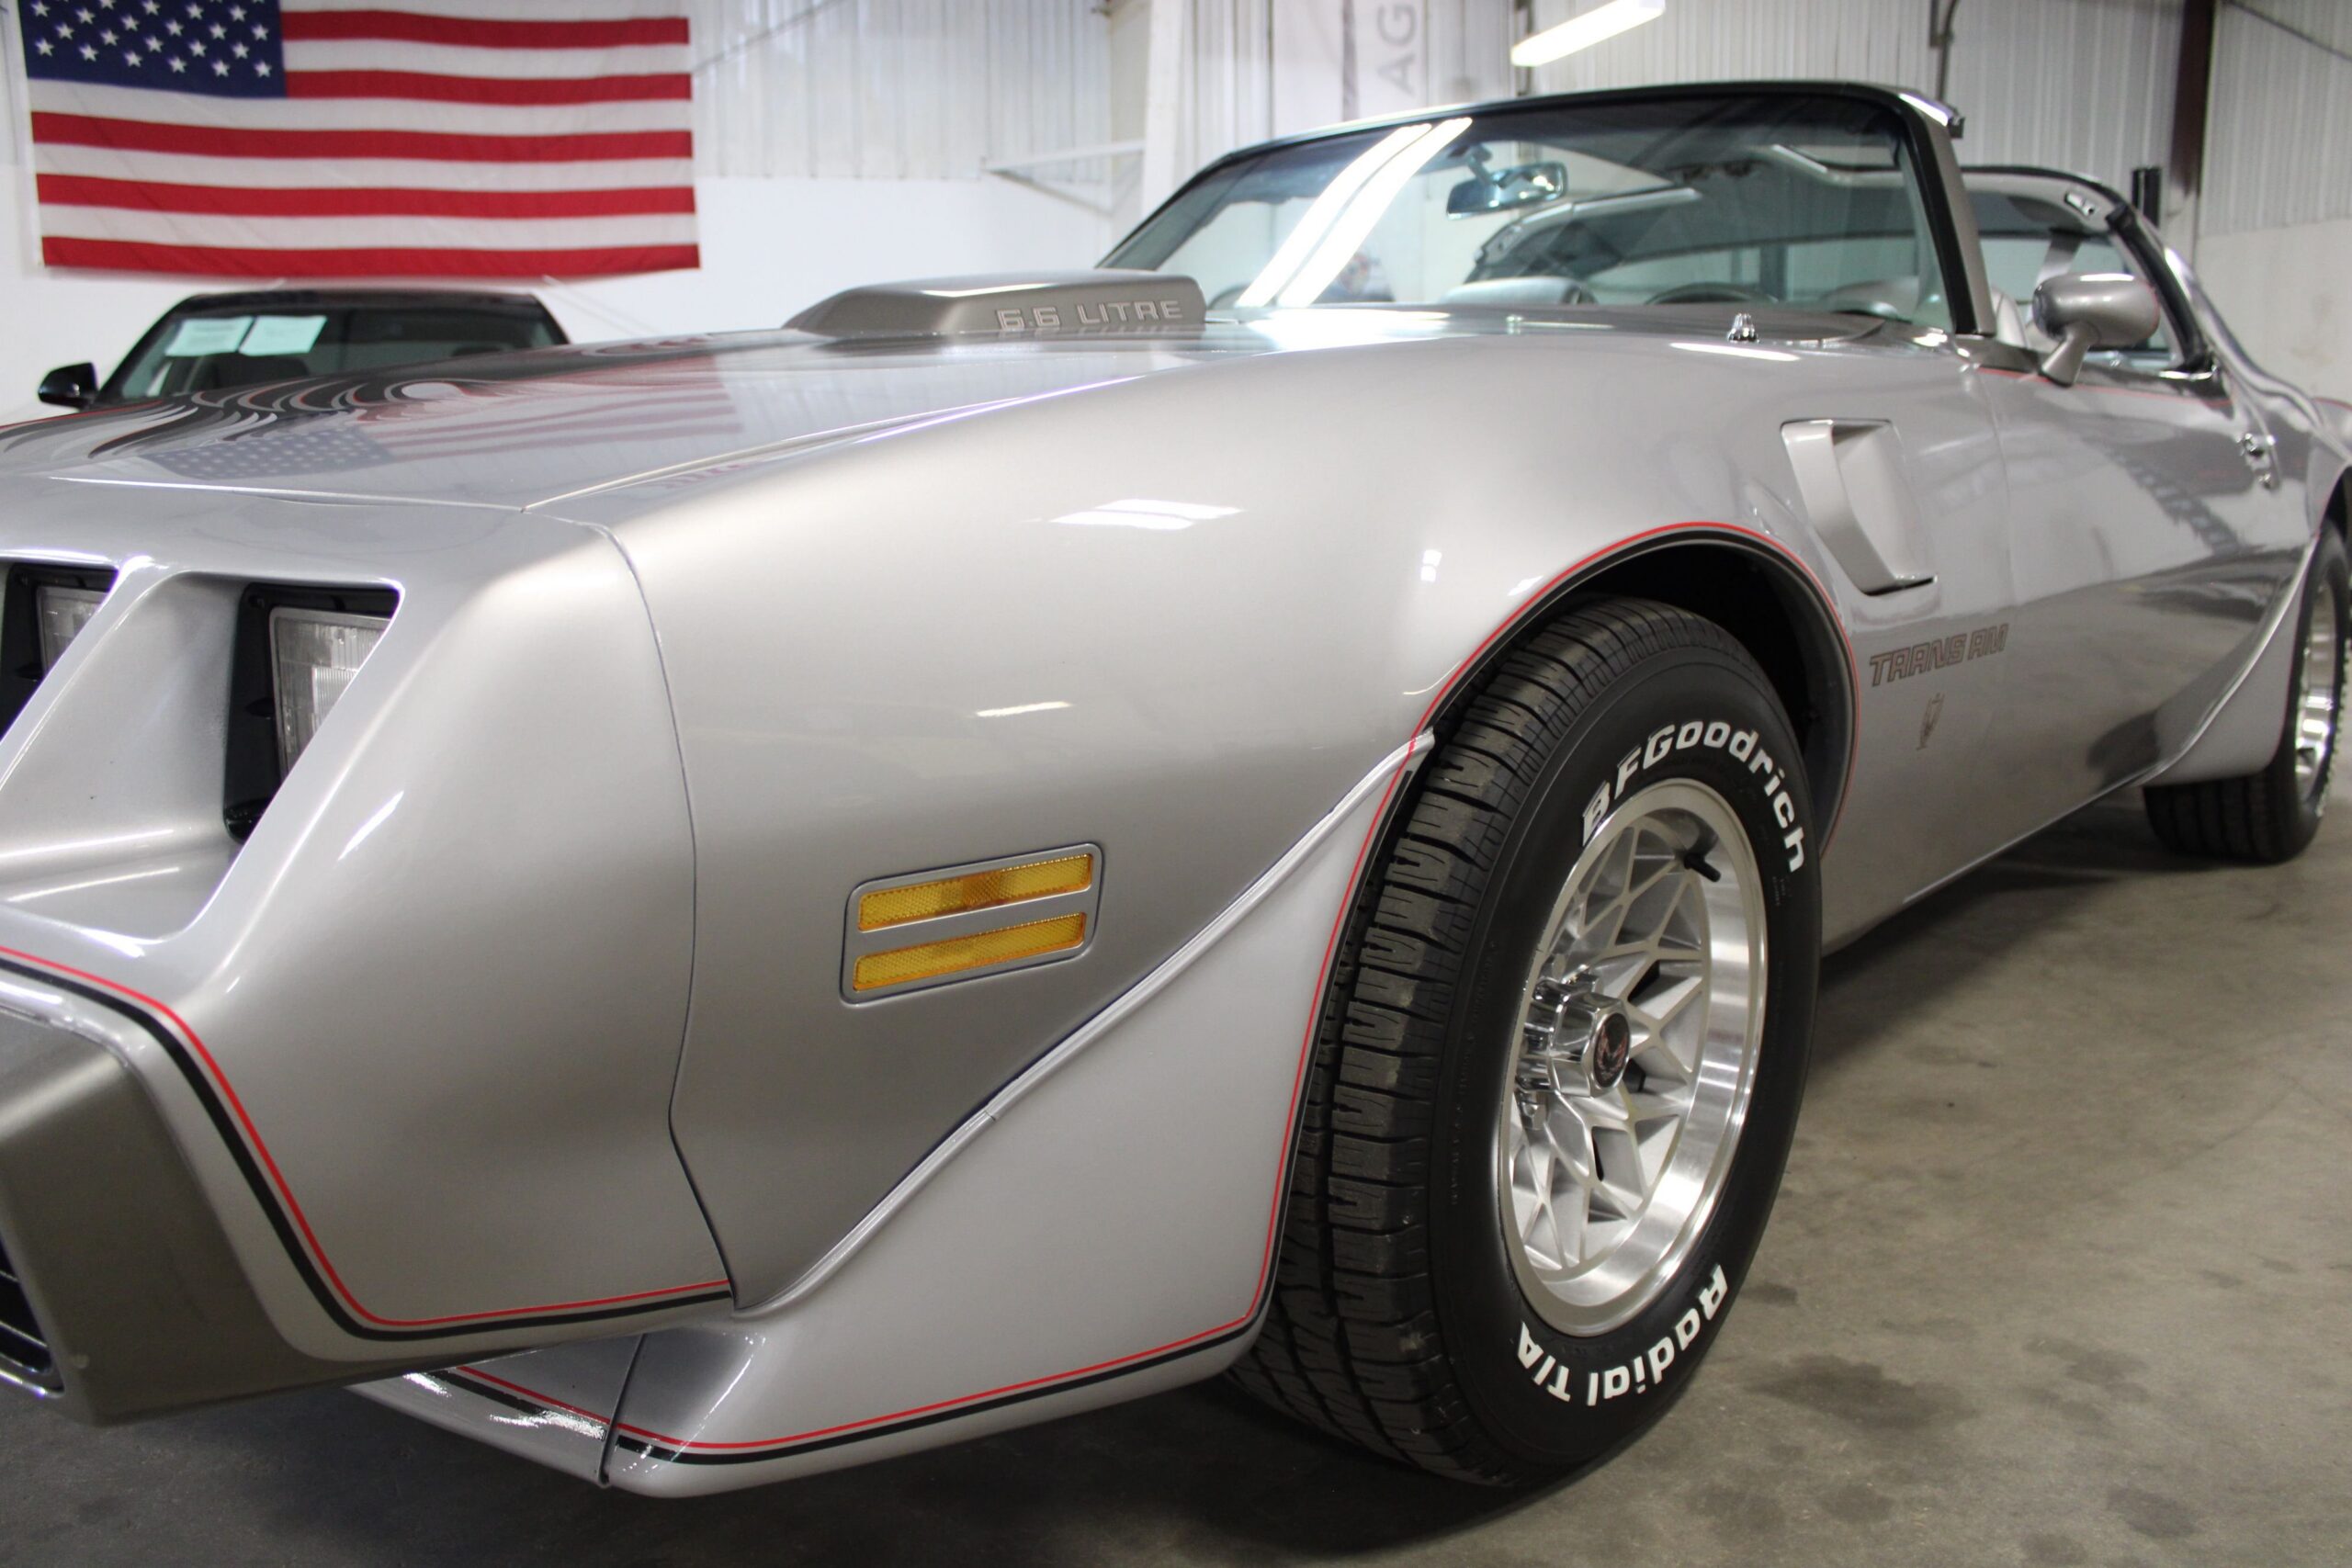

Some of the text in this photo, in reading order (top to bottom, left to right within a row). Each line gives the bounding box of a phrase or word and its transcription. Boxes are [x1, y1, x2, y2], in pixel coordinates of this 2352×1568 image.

[996, 299, 1184, 332] 6.6 LITRE
[1869, 623, 2010, 688] TRANS AM
[1516, 1264, 1729, 1407] Radial T/A
